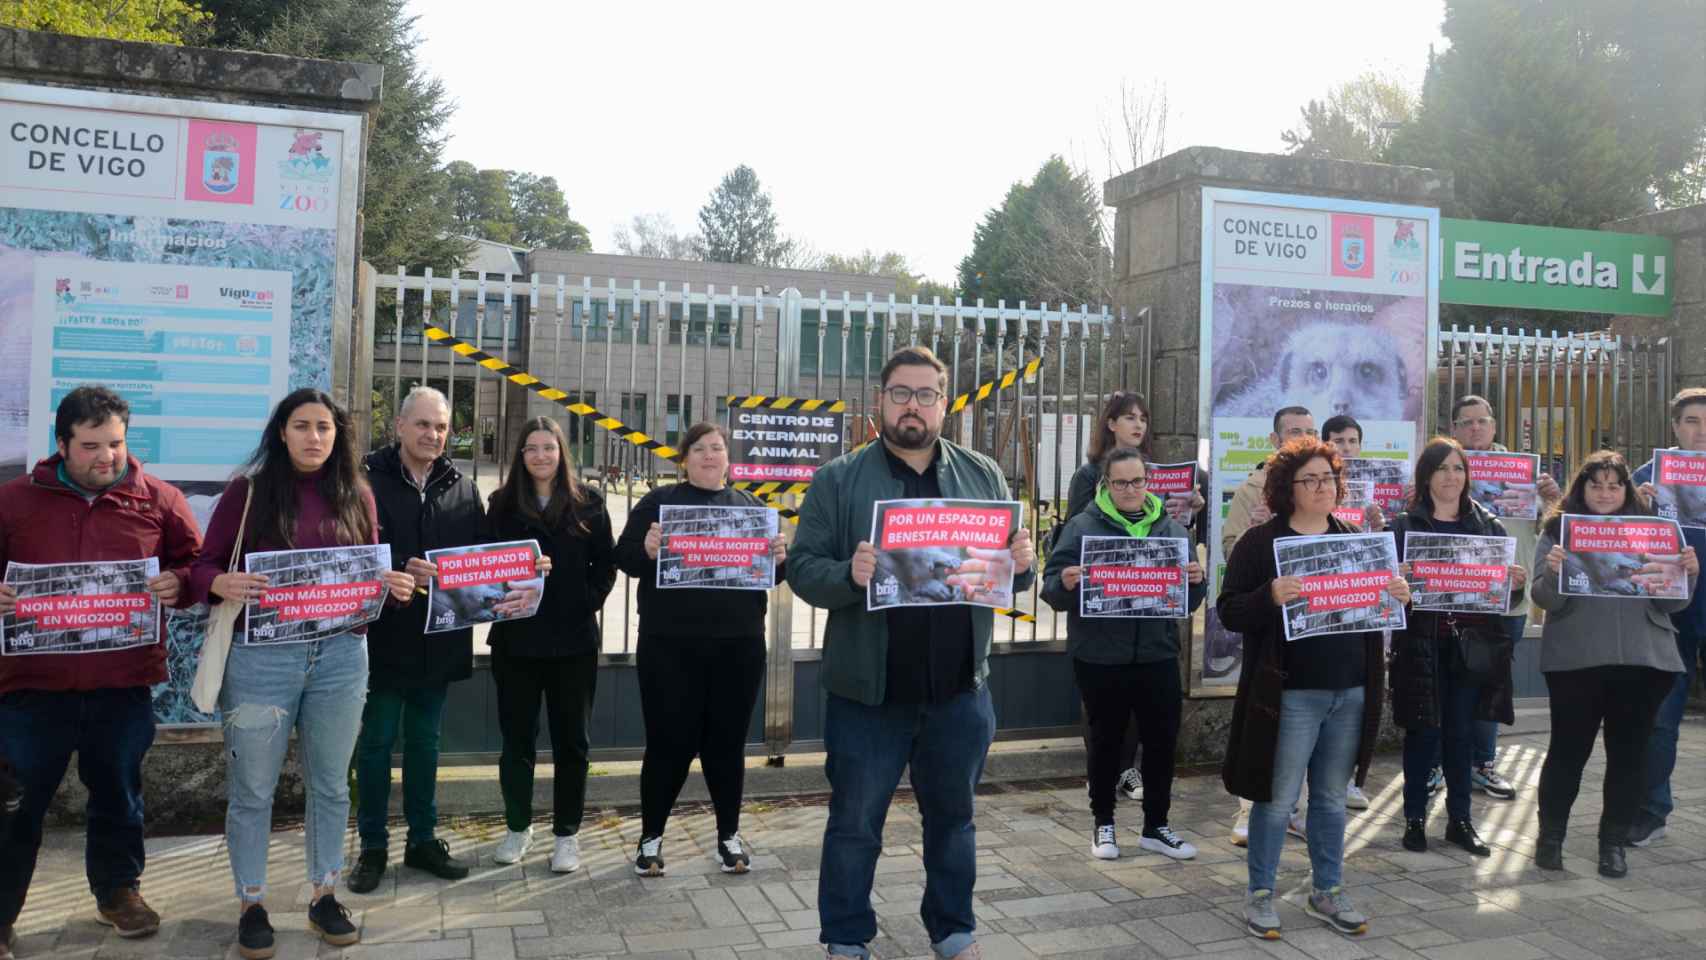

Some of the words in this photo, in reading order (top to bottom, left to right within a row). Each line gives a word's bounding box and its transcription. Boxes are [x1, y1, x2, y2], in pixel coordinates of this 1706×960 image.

[10, 122, 164, 153] CONCELLO
[28, 150, 65, 171] DE
[78, 154, 146, 178] VIGO
[279, 194, 329, 212] ZOO
[1223, 217, 1318, 240] CONCELLO
[1234, 239, 1258, 256] DE
[1264, 241, 1307, 260] VIGO
[1454, 241, 1619, 288] Entrada
[1269, 296, 1311, 310] Prezos
[1325, 301, 1376, 313] horarios
[739, 413, 809, 427] CENTRO
[811, 416, 835, 428] DE
[732, 429, 839, 443] EXTERMINIO
[748, 446, 820, 459] ANIMAL
[1483, 460, 1515, 468] ESPAZO
[1664, 459, 1686, 469] POR
[1689, 461, 1705, 470] UN
[733, 466, 814, 477] CLAUSURA
[1493, 471, 1527, 480] ANIMAL
[1375, 487, 1400, 496] ORTES
[889, 514, 912, 526] POR
[917, 513, 935, 524] UN
[938, 513, 986, 526] ESPAZO
[989, 515, 1006, 527] DE
[1335, 511, 1361, 521] ORTES
[888, 530, 948, 544] BENESTAR
[951, 530, 1001, 544] ANIMAL
[1574, 526, 1596, 536] POR
[1599, 526, 1615, 536] UN
[1618, 526, 1657, 537] ESPAZO
[1660, 527, 1673, 537] DE
[672, 540, 696, 549] NON
[699, 538, 725, 549] MÁIS
[725, 541, 766, 551] MORTES
[1575, 539, 1628, 549] BENESTAR
[1630, 540, 1673, 550] ANIMAL
[441, 560, 463, 571] POR
[465, 558, 480, 568] UN
[482, 553, 516, 565] ESPAZO
[518, 551, 531, 561] DE
[687, 554, 701, 562] EN
[703, 554, 750, 563] VIGOZOO
[443, 571, 492, 585] BENESTAR
[494, 566, 530, 579] ANIMAL
[1093, 570, 1114, 579] NON
[1117, 568, 1140, 579] MÁIS
[1141, 571, 1178, 580] MORTES
[1416, 566, 1438, 575] NON
[1441, 564, 1463, 576] MÁIS
[1465, 567, 1503, 578] MORTES
[875, 582, 898, 595] bng
[1107, 583, 1120, 592] EN
[1121, 584, 1163, 593] VIGOZOO
[1323, 578, 1349, 591] MÁIS
[1430, 578, 1442, 587] EN
[1444, 579, 1487, 590] VIGOZOO
[264, 592, 294, 603] NON
[297, 588, 327, 601] MÁIS
[330, 585, 378, 598] MORTES
[1312, 596, 1328, 607] EN
[1330, 591, 1376, 606] VIGOZOO
[21, 601, 53, 613] NON
[57, 597, 90, 611] MÁIS
[93, 597, 146, 609] MORTES
[284, 605, 300, 615] EN
[303, 601, 358, 614] VIGOZOO
[43, 614, 61, 625] EN
[65, 611, 125, 625] VIGOZOO
[253, 627, 275, 638] bng
[10, 636, 34, 647] bng
